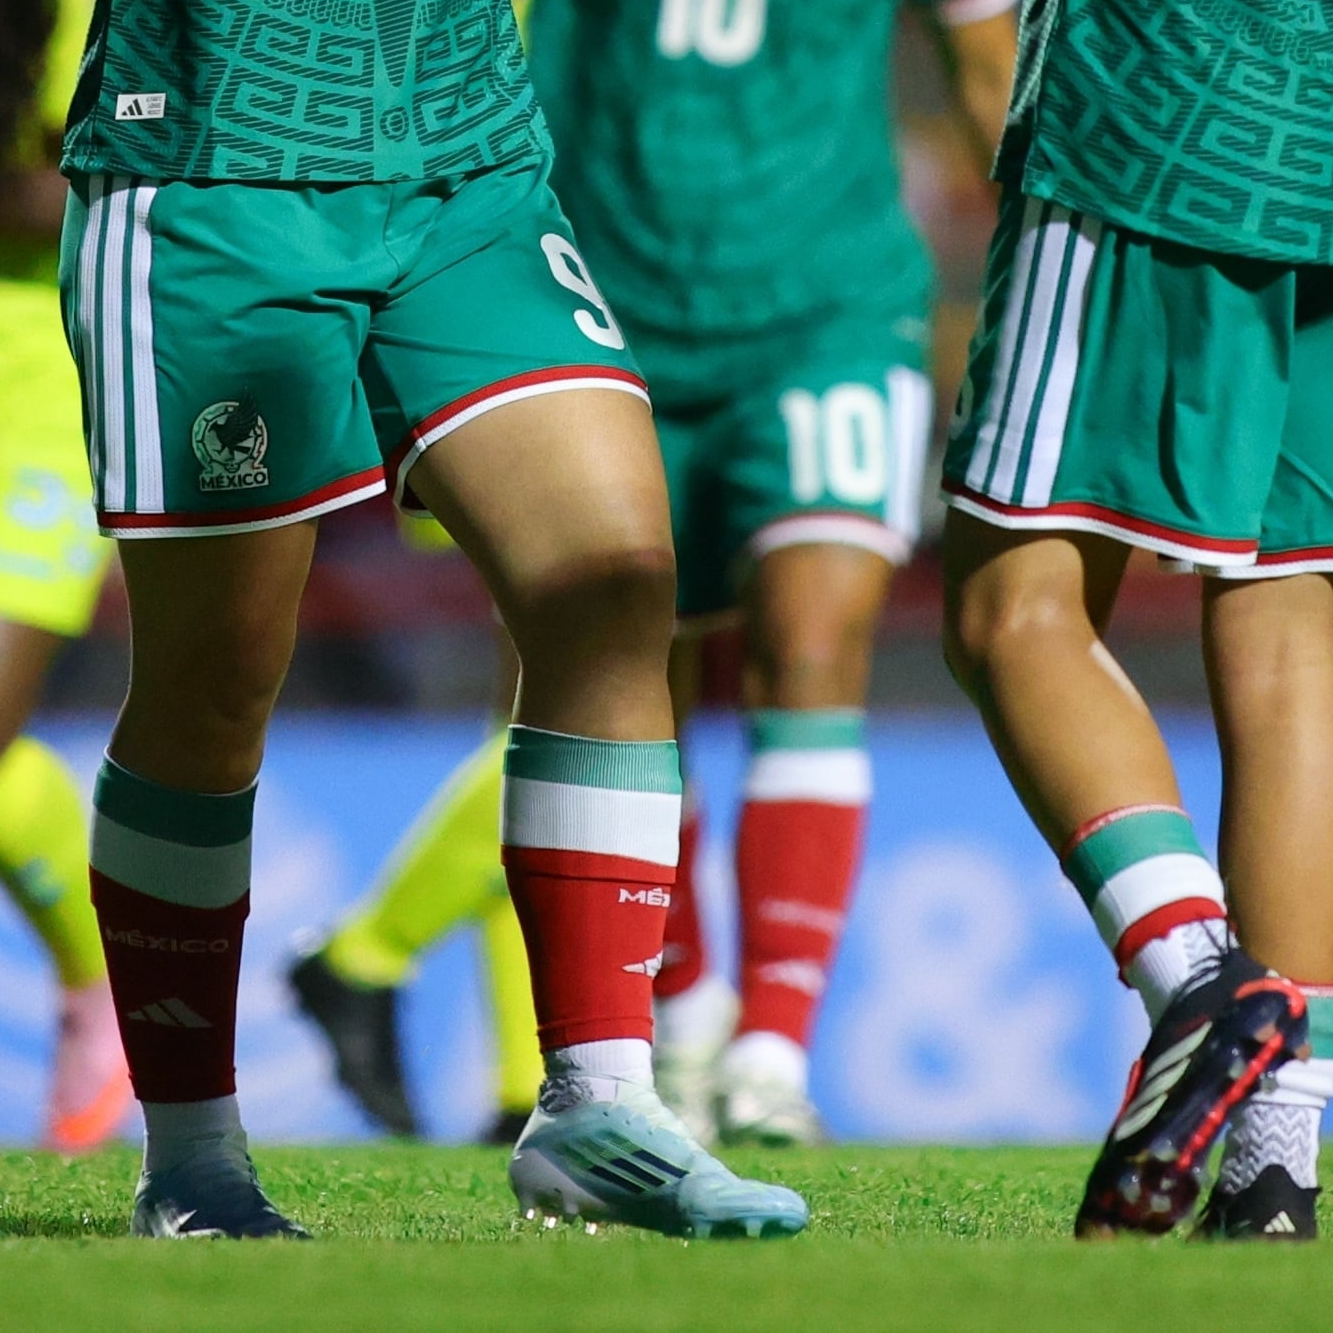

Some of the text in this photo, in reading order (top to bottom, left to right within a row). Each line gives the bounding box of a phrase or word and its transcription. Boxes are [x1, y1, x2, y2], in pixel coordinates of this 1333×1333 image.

[539, 232, 626, 351] 9
[778, 381, 887, 505] 10
[105, 927, 229, 953] MÉXICO
